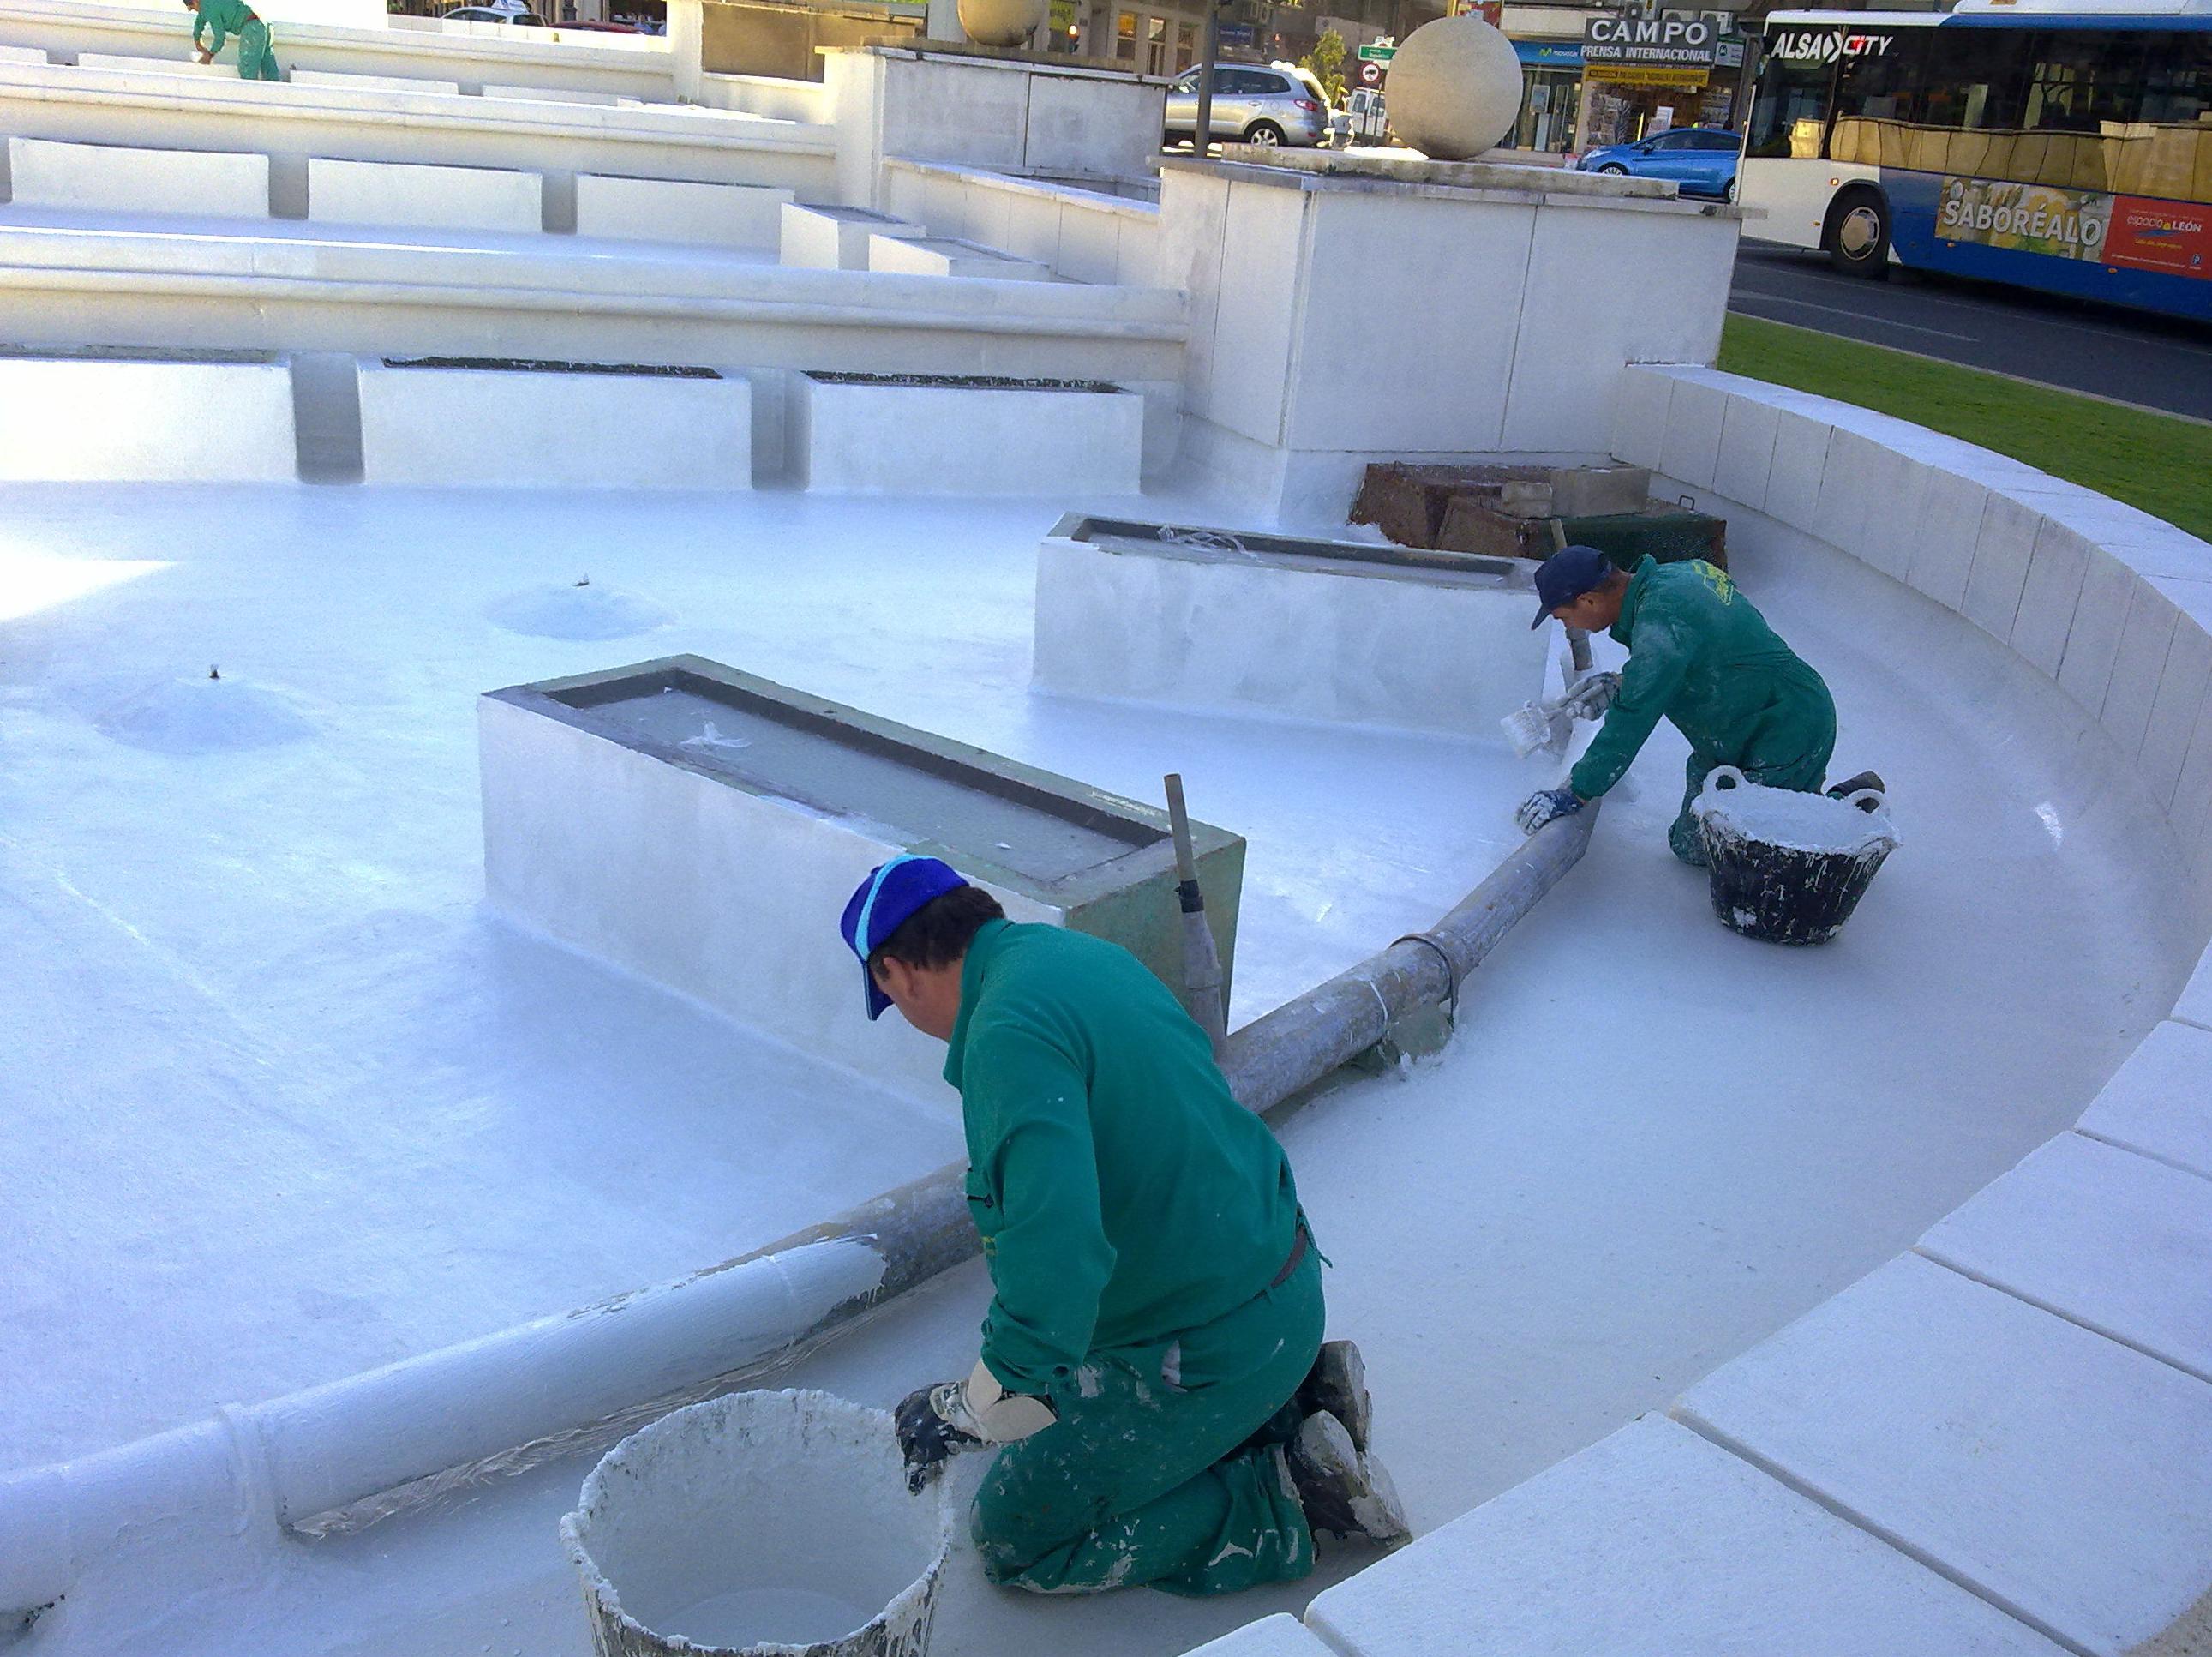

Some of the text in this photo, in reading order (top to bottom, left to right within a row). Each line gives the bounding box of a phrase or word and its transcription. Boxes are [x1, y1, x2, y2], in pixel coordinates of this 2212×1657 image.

[1591, 20, 1709, 45] CAMPO
[1580, 45, 1712, 62] PRENSA INTERNACIONAL
[1770, 33, 1823, 60] ALSA
[1843, 35, 1894, 56] CITY
[1943, 200, 2101, 247] SABORÉALO
[2172, 220, 2203, 232] LEÓN
